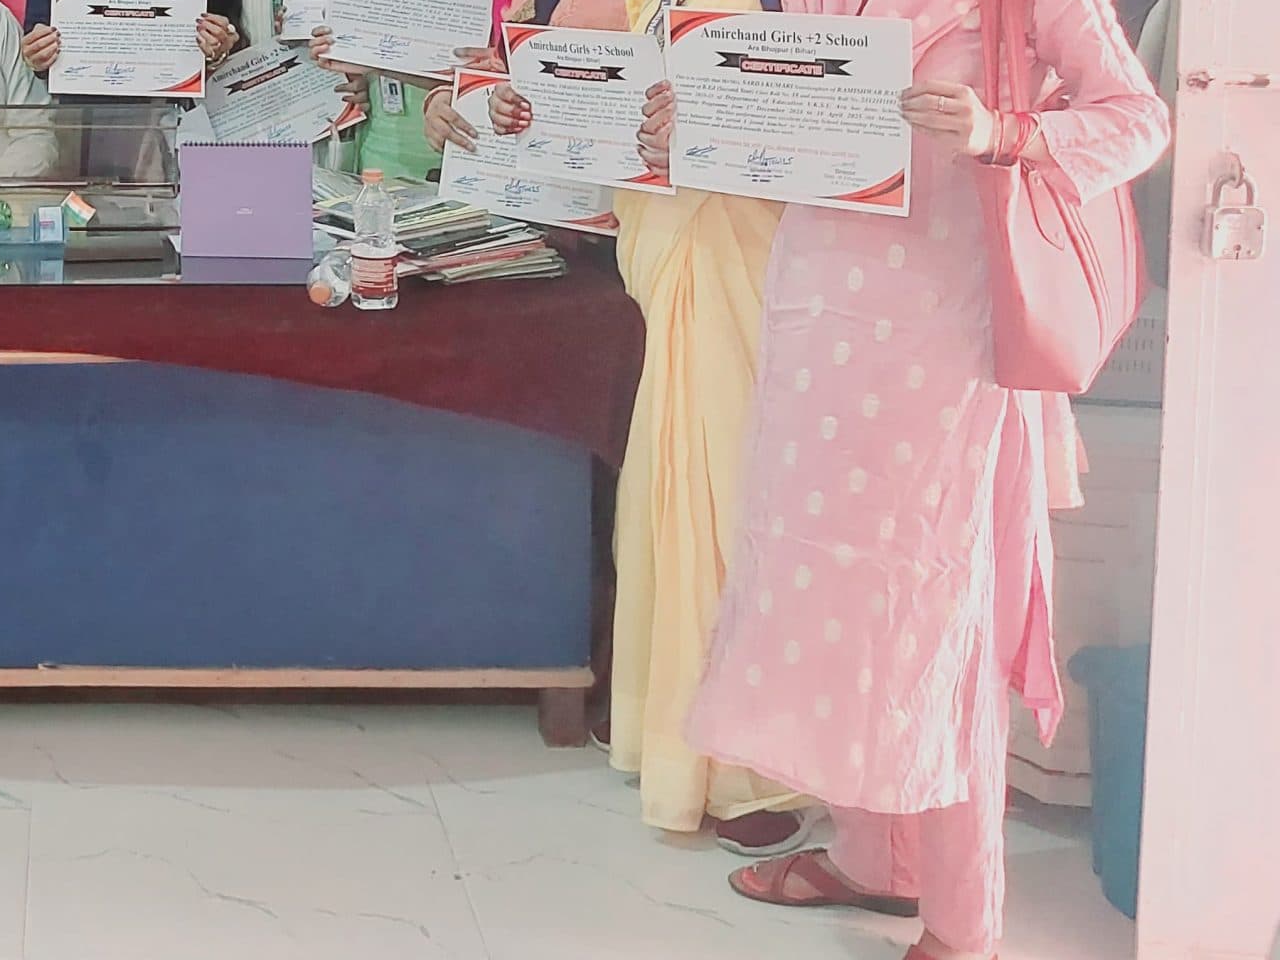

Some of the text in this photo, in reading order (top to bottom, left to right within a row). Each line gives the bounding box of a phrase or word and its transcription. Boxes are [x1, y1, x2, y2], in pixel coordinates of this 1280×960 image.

[700, 27, 767, 43] Amirchand
[770, 30, 802, 45] Girls
[826, 33, 869, 48] School
[528, 40, 567, 53] Amirchand
[569, 43, 590, 55] Girls
[605, 45, 634, 57] School
[741, 60, 824, 76] CERTIFICATE
